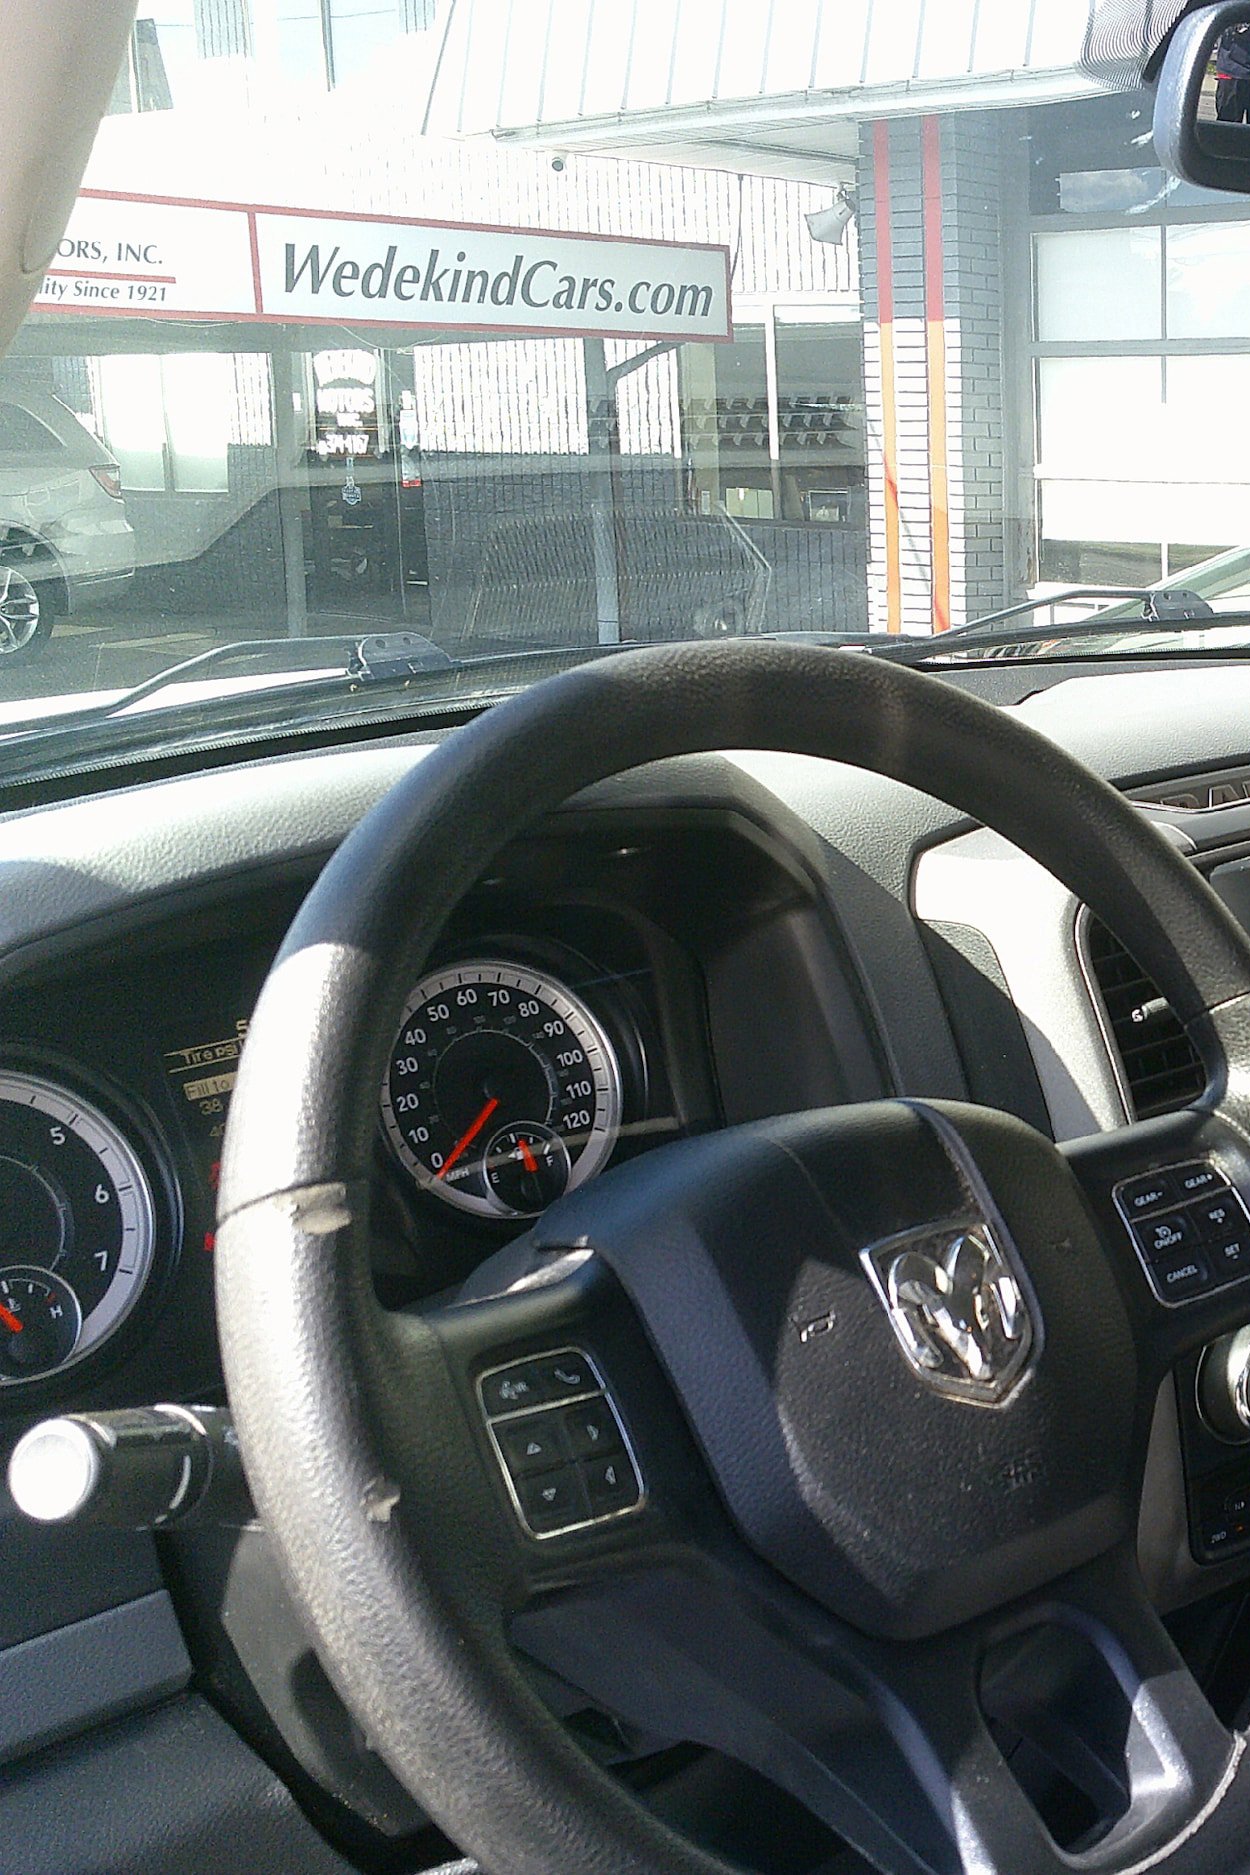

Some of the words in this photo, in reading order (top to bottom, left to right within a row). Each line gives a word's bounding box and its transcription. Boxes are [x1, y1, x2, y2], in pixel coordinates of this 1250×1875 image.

[117, 242, 163, 265] INC.
[284, 243, 714, 317] WedekindCars.com
[73, 280, 120, 300] Since
[127, 284, 166, 302] 1921
[457, 988, 477, 1006] 60
[488, 990, 510, 1006] 70
[426, 1004, 450, 1022] 50
[518, 1000, 540, 1018] 80
[405, 1028, 426, 1046] 40
[543, 1020, 565, 1037] 90
[396, 1057, 418, 1075] 30
[556, 1049, 584, 1068] 100
[566, 1080, 592, 1099] 110
[397, 1093, 419, 1112] 20
[562, 1110, 591, 1129] 120
[50, 1127, 66, 1146] 5
[408, 1127, 430, 1144] 10
[431, 1152, 443, 1168] 0
[546, 1156, 554, 1167] F
[446, 1168, 469, 1182] MPH
[491, 1173, 500, 1184] E
[95, 1183, 110, 1204] 6
[94, 1251, 108, 1271] 7
[1166, 1264, 1198, 1283] CANCEL
[50, 1305, 63, 1319] H
